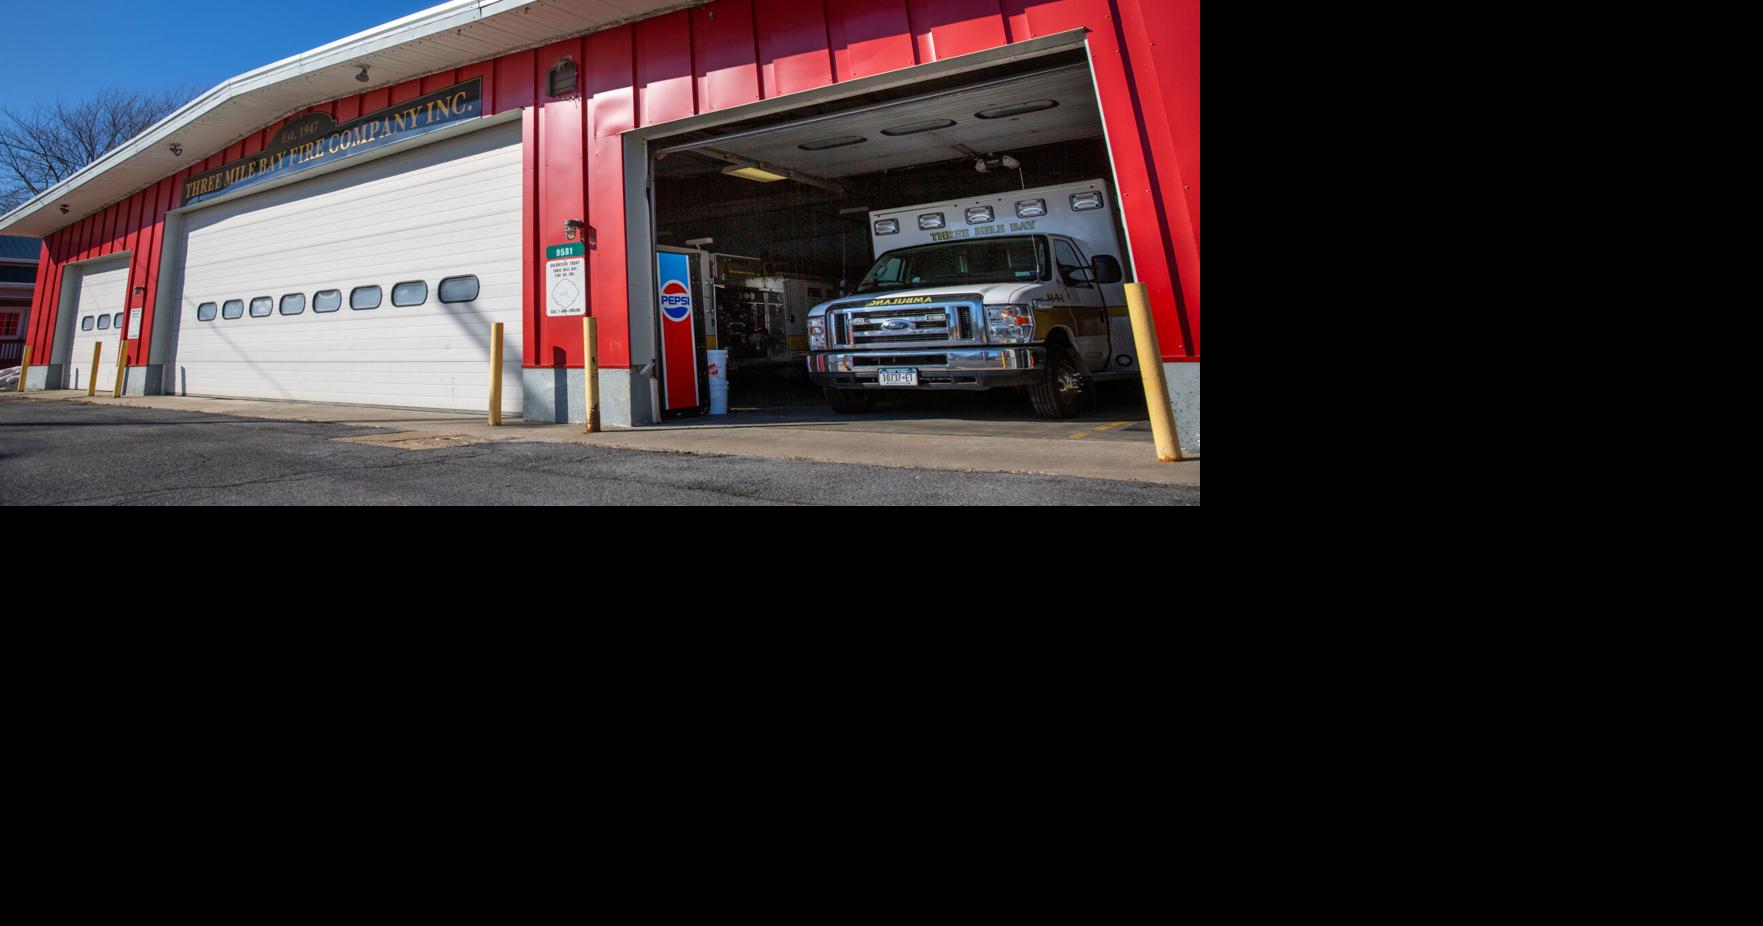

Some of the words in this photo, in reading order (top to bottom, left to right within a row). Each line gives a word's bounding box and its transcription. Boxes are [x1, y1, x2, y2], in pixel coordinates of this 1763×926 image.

[282, 130, 297, 144] Est.
[300, 121, 319, 138] 1947
[186, 172, 223, 199] THREE
[224, 161, 257, 187] MILE
[259, 150, 287, 176] BAY
[290, 137, 325, 167] FIRE
[329, 105, 422, 154] COMPANY
[426, 91, 472, 124] INC.
[930, 228, 969, 241] THREE
[975, 224, 1005, 236] MILE
[1010, 220, 1036, 232] BAY
[661, 296, 690, 306] PEPSI
